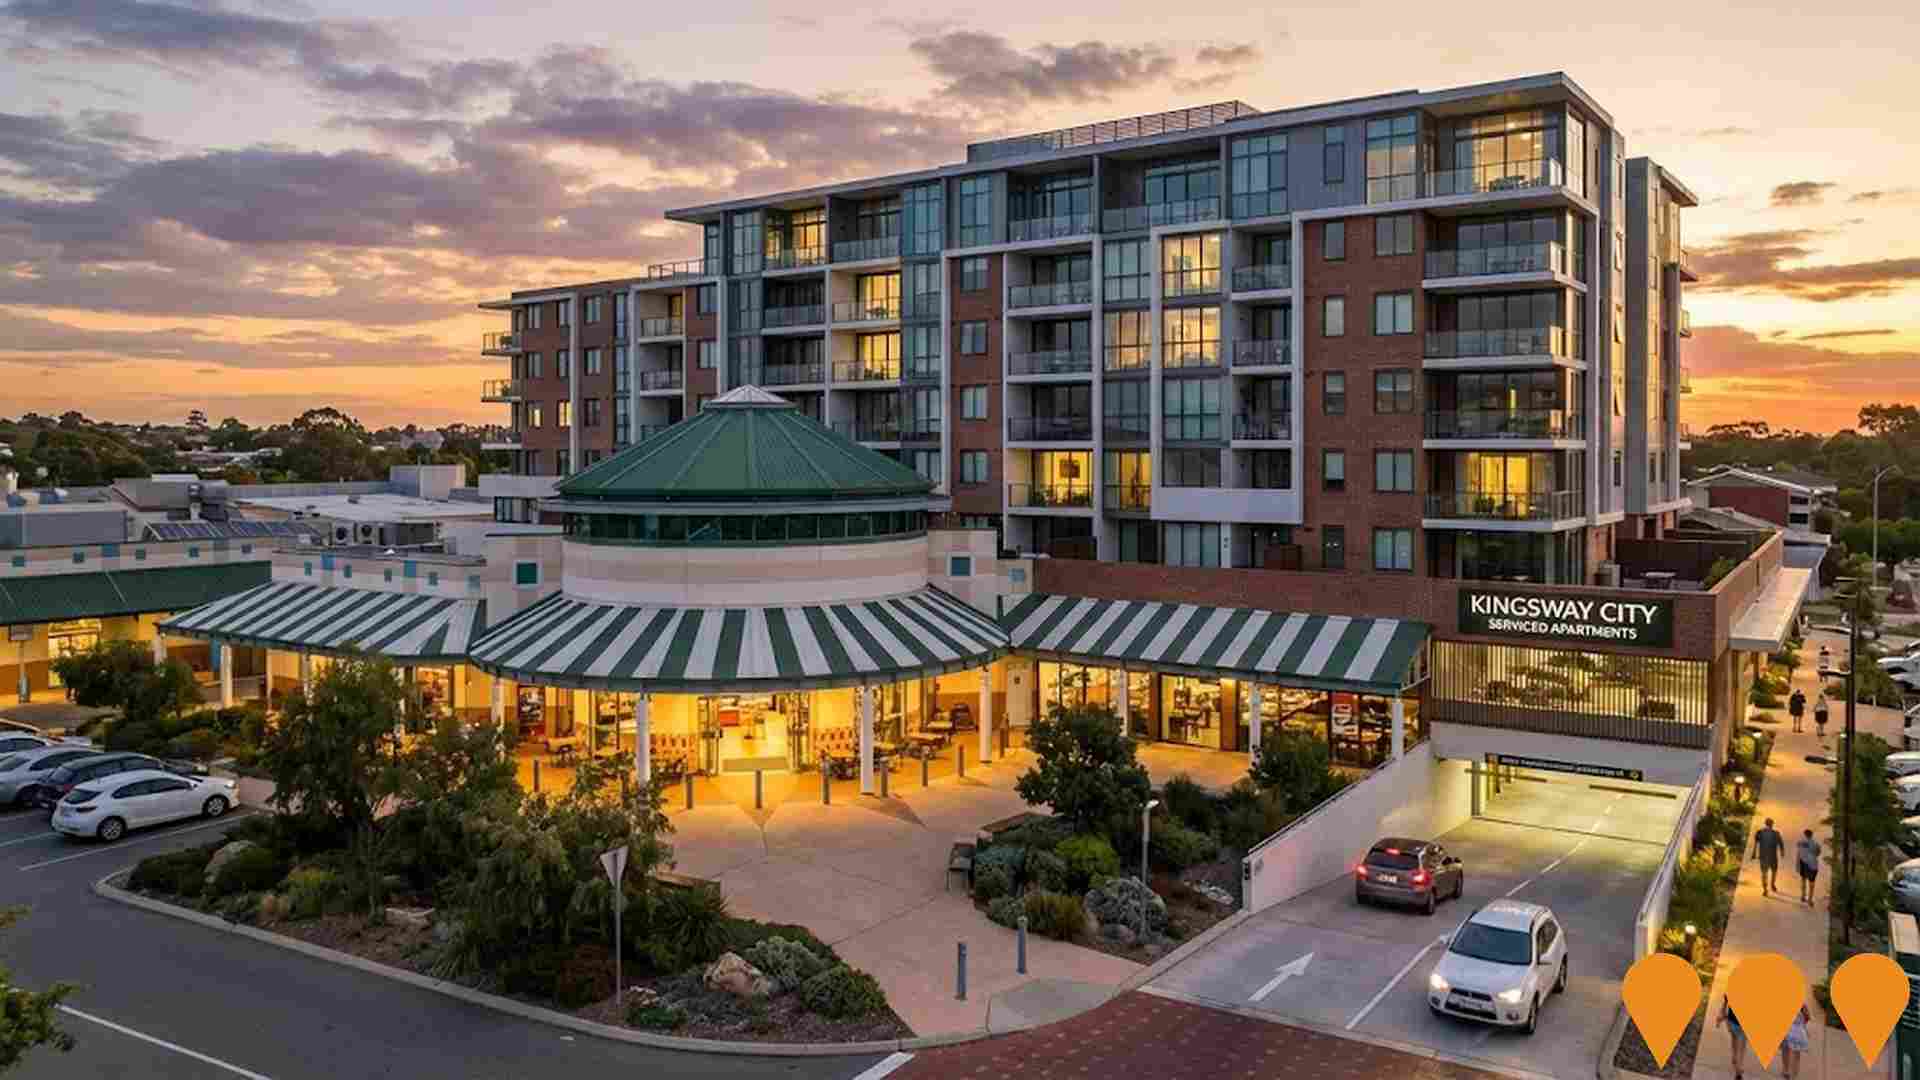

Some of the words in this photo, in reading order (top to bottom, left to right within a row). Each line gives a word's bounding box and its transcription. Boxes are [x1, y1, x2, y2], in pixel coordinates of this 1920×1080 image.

[1470, 594, 1594, 620] KINGSWAY
[1600, 602, 1658, 624] CITY
[1550, 623, 1638, 640] APARTMENTS
